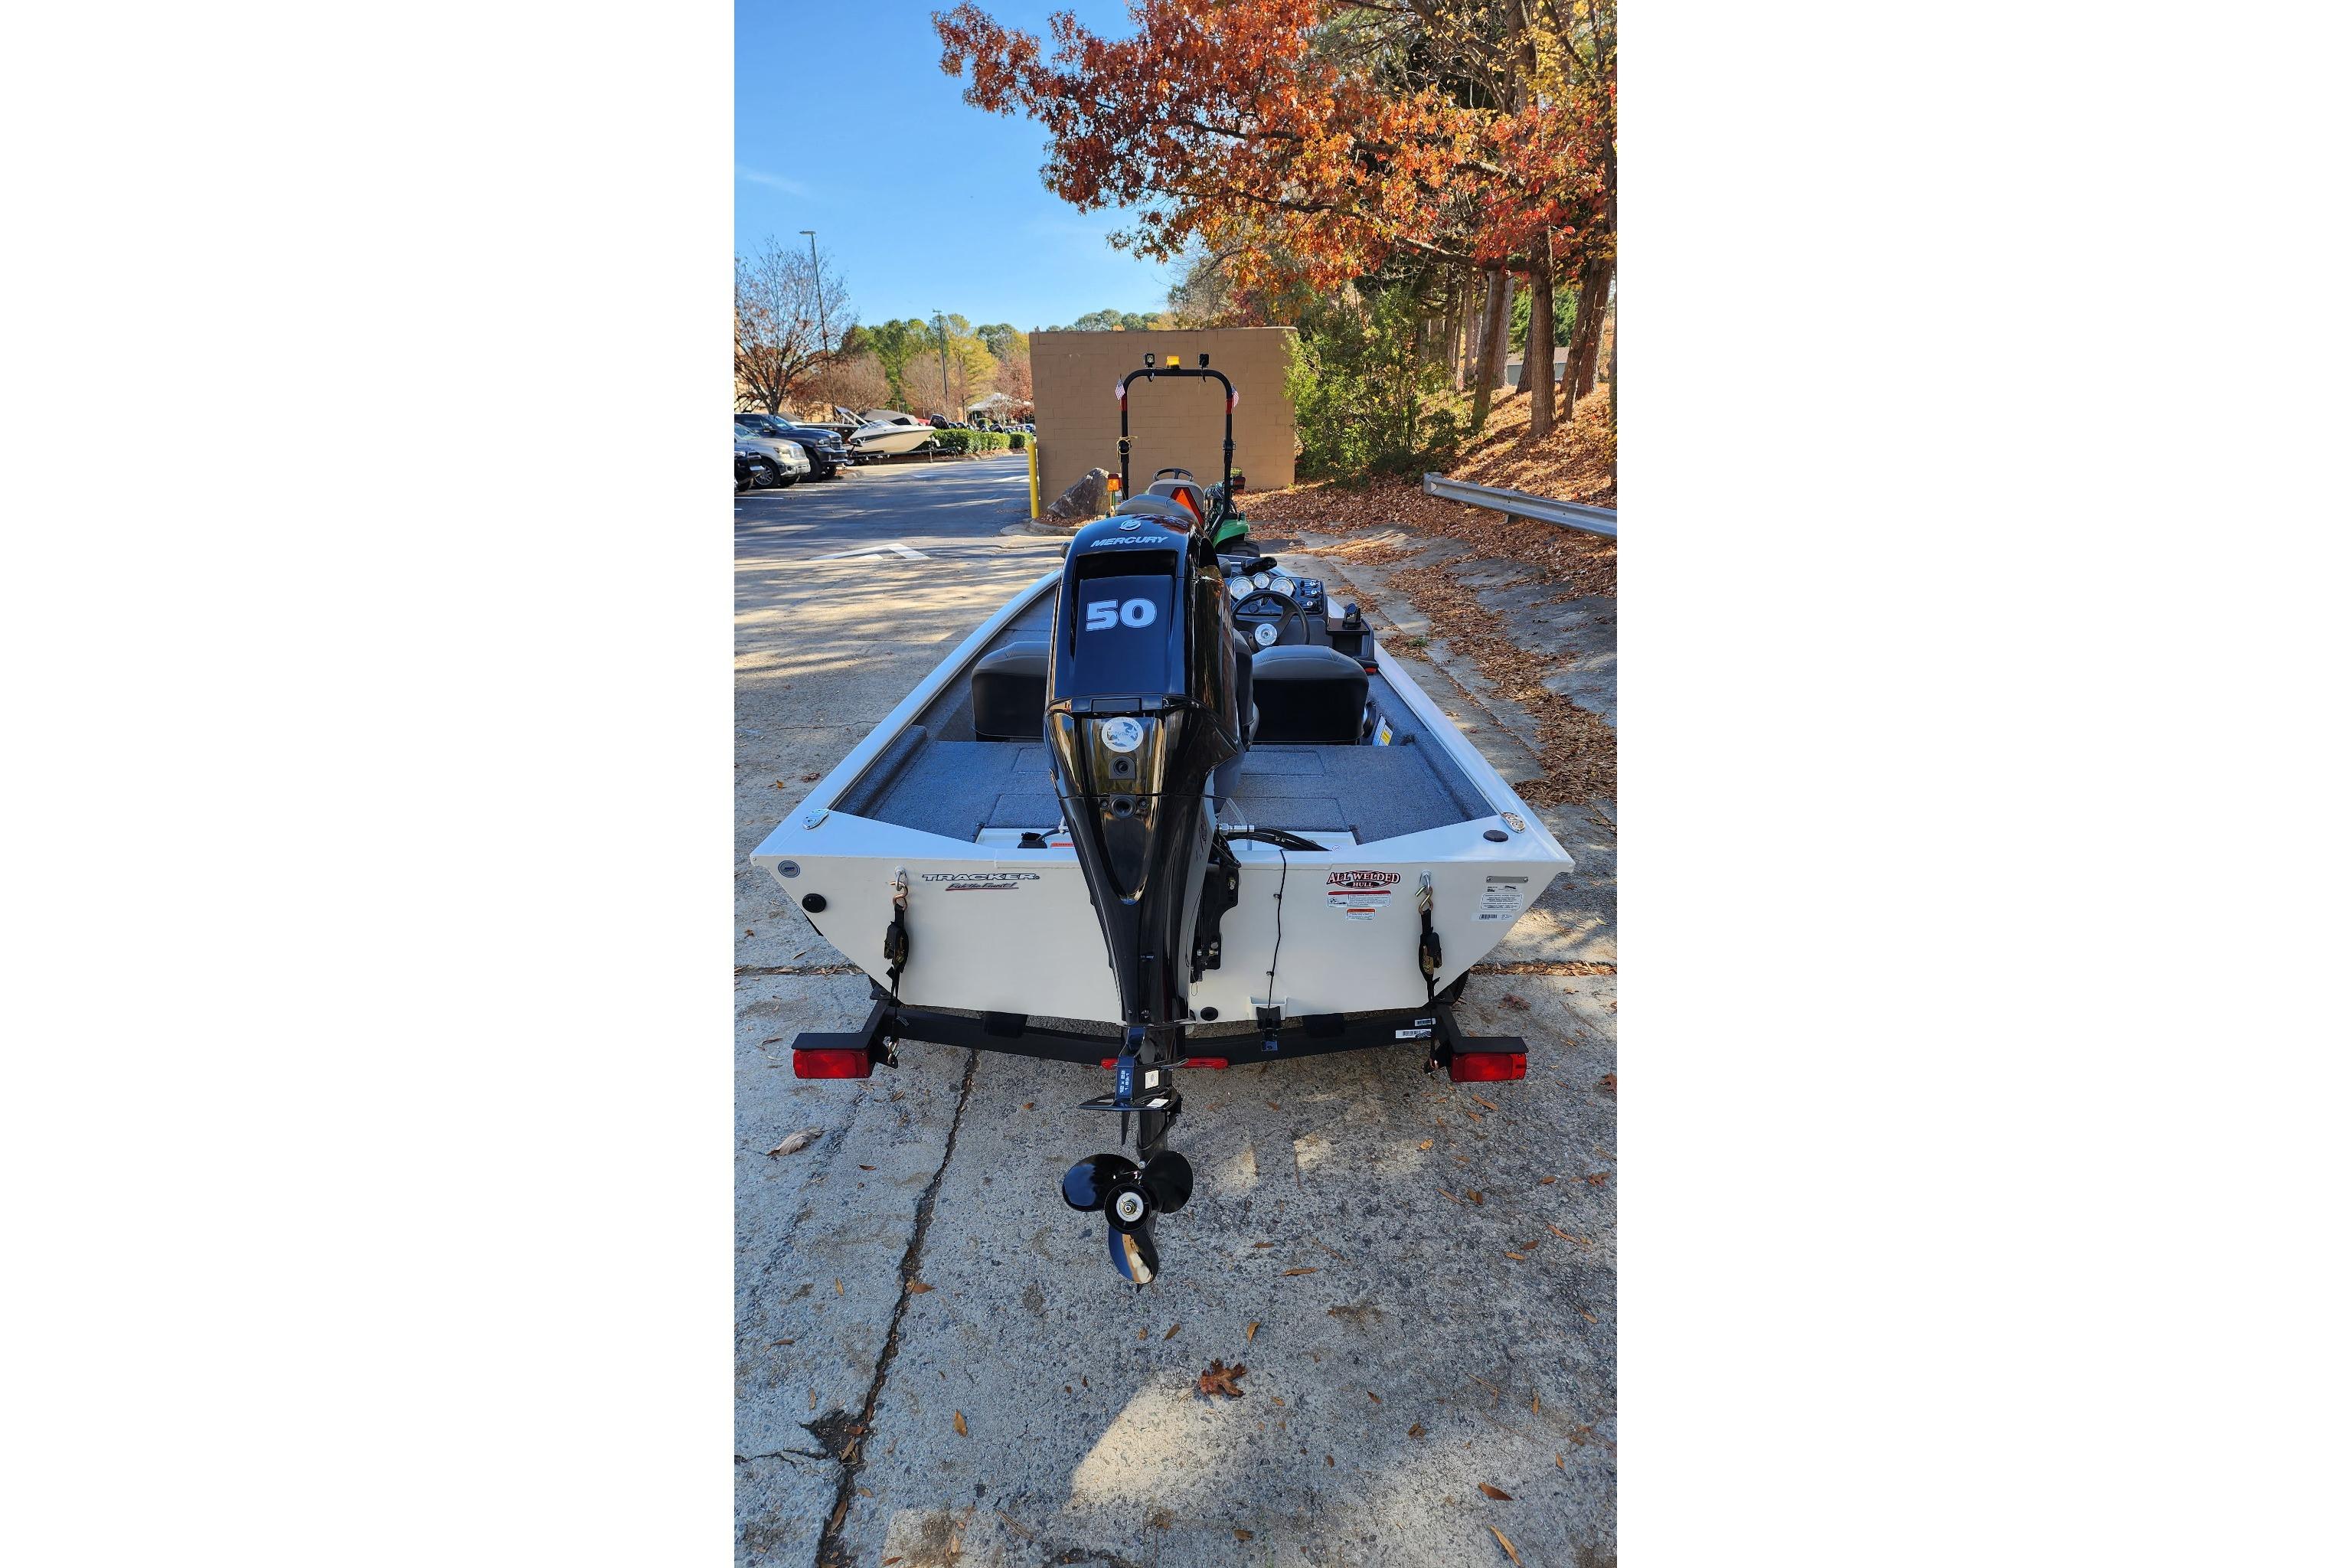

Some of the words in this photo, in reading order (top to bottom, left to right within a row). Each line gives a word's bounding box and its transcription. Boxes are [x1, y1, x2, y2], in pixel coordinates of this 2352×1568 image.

[1090, 536, 1168, 547] MERCURY
[1086, 597, 1158, 632] 50
[922, 873, 1035, 881] TRACKER
[1327, 872, 1351, 884] ALL
[1352, 872, 1400, 884] WELDED
[1119, 1085, 1125, 1093] 12
